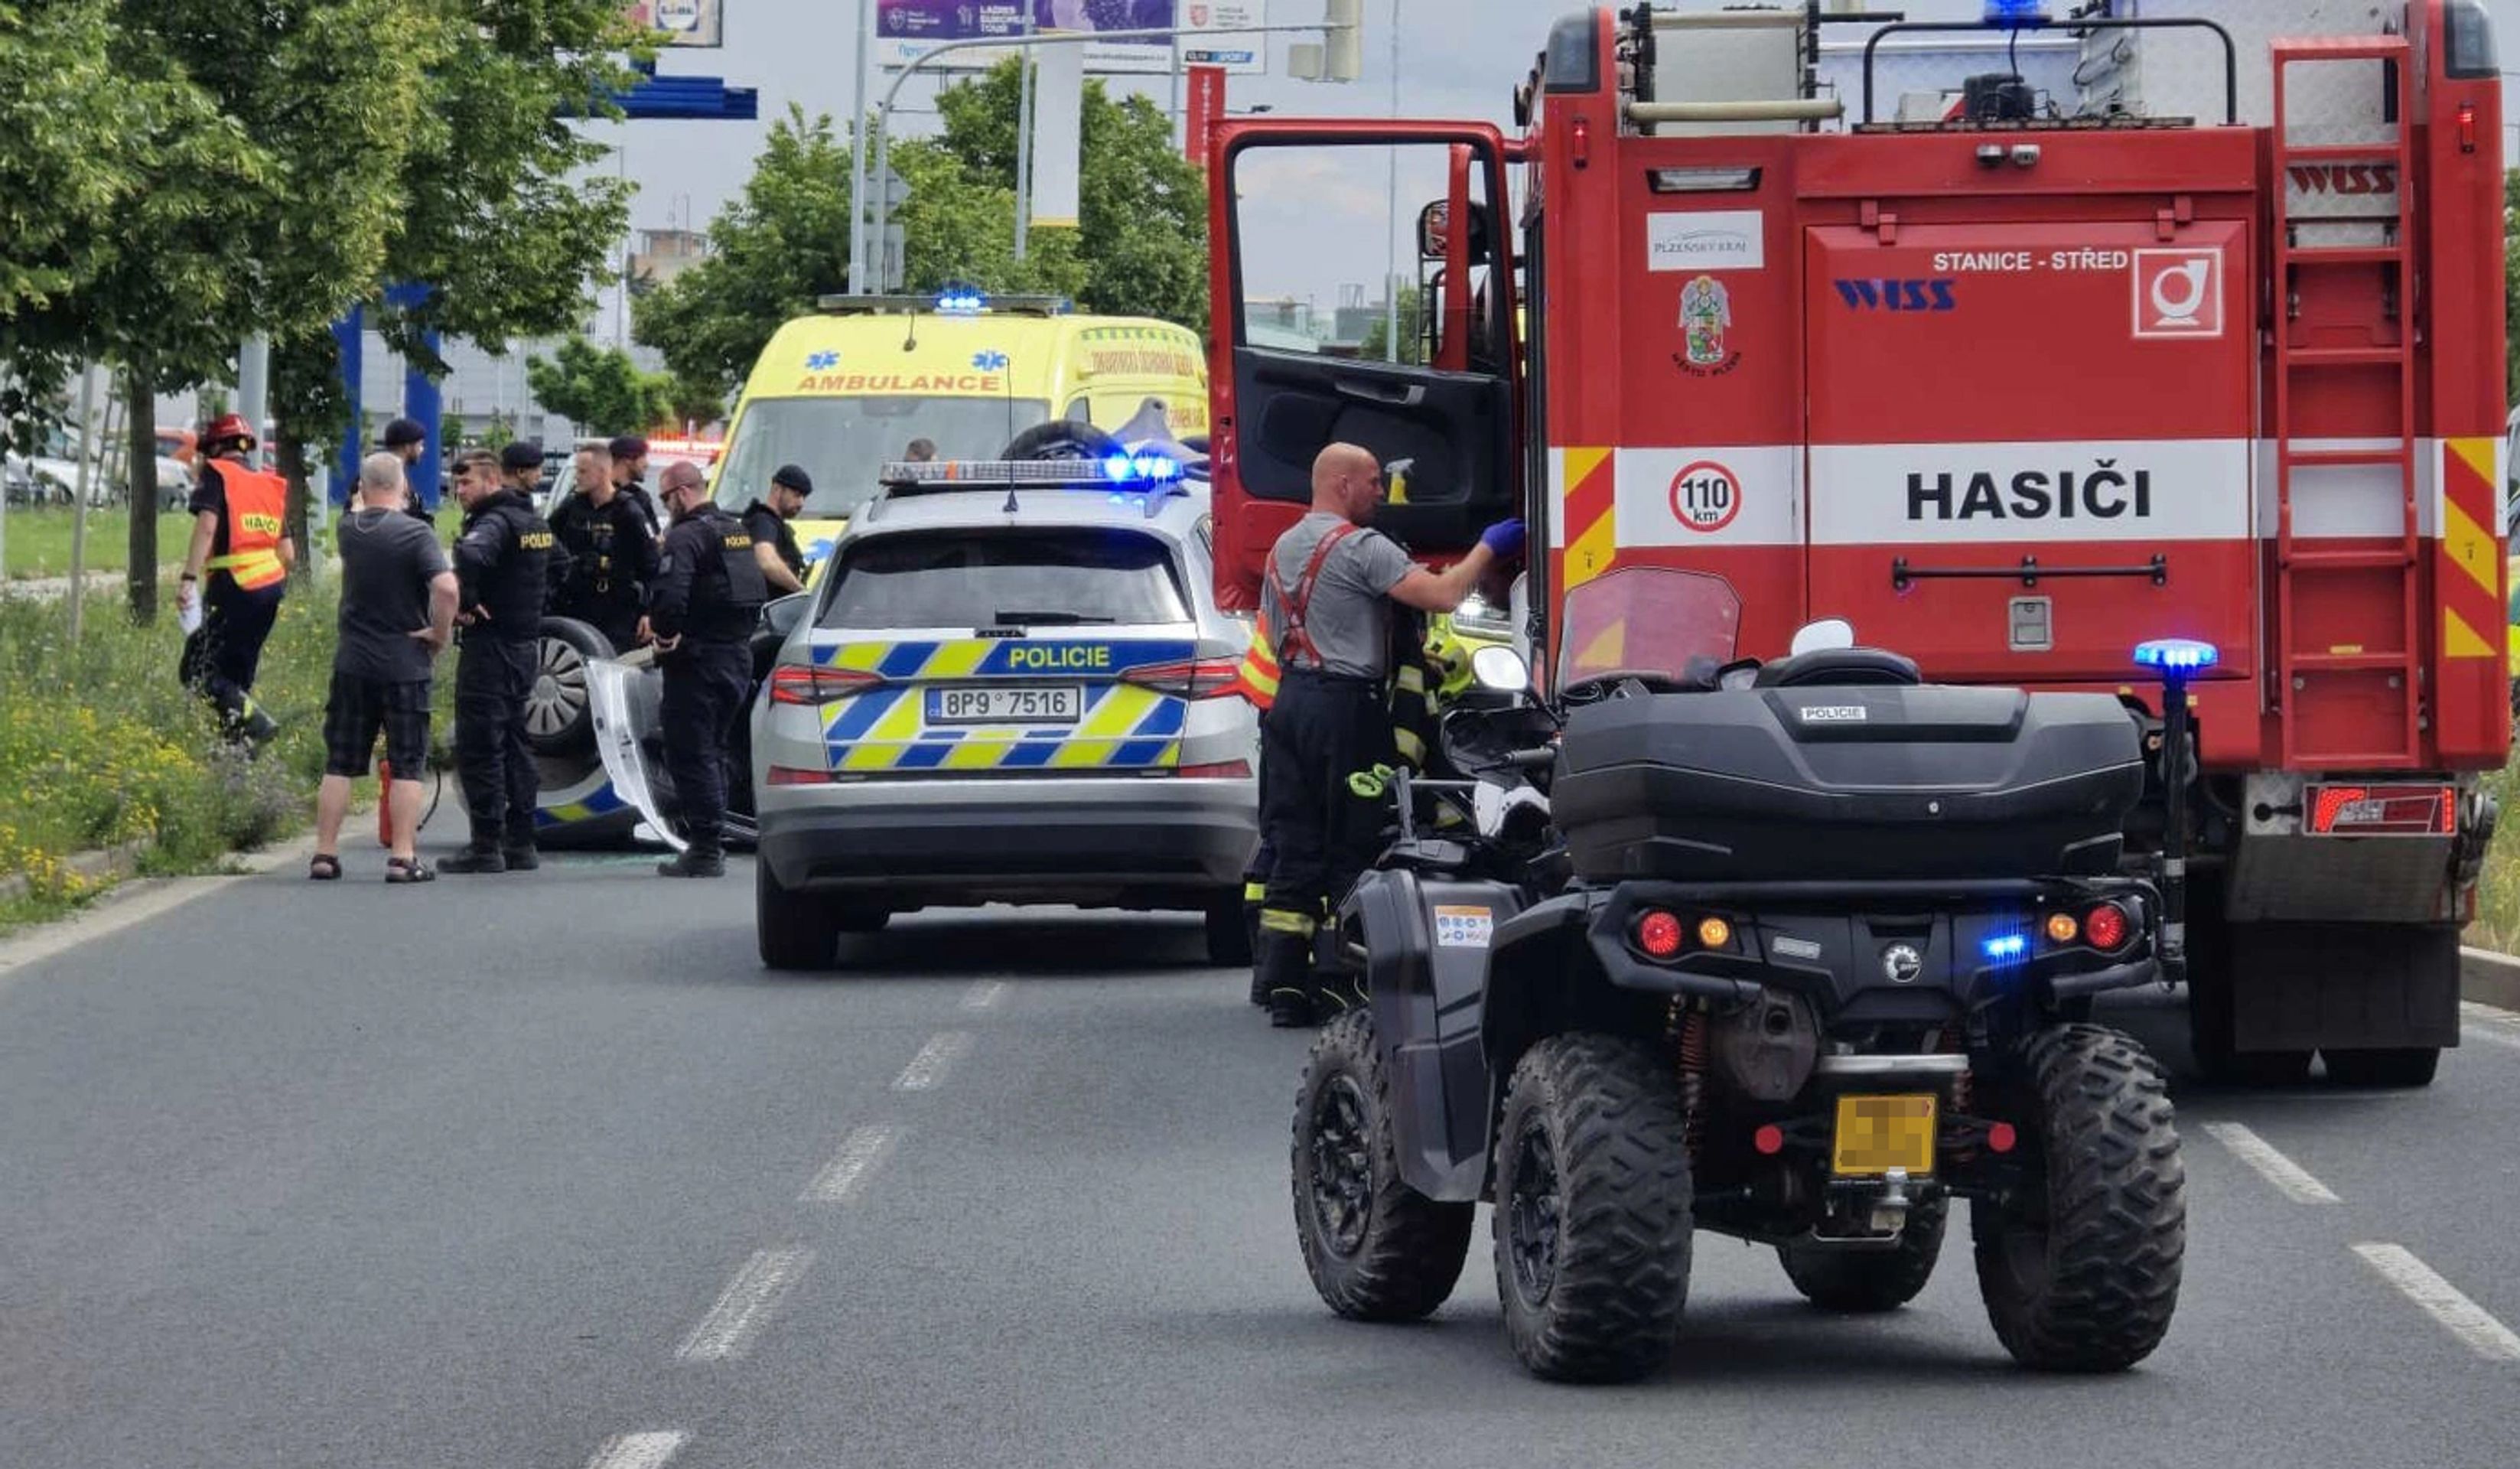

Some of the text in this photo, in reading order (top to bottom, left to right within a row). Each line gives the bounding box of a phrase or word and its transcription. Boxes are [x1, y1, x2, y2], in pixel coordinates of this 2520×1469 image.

[980, 15, 1036, 24] EUROPE
[2285, 164, 2395, 194] WISS
[1934, 252, 2031, 271] STANICE
[2051, 248, 2128, 269] STŘED
[1835, 279, 1956, 311] WISS
[798, 375, 1000, 391] AMBULANCE
[1681, 478, 1729, 509] 110
[1907, 458, 2150, 520] HASIČI
[1694, 509, 1718, 522] km
[1010, 647, 1111, 668] POLICIE
[946, 692, 1066, 715] 8P9 7516
[1805, 708, 1862, 718] POLICIE
